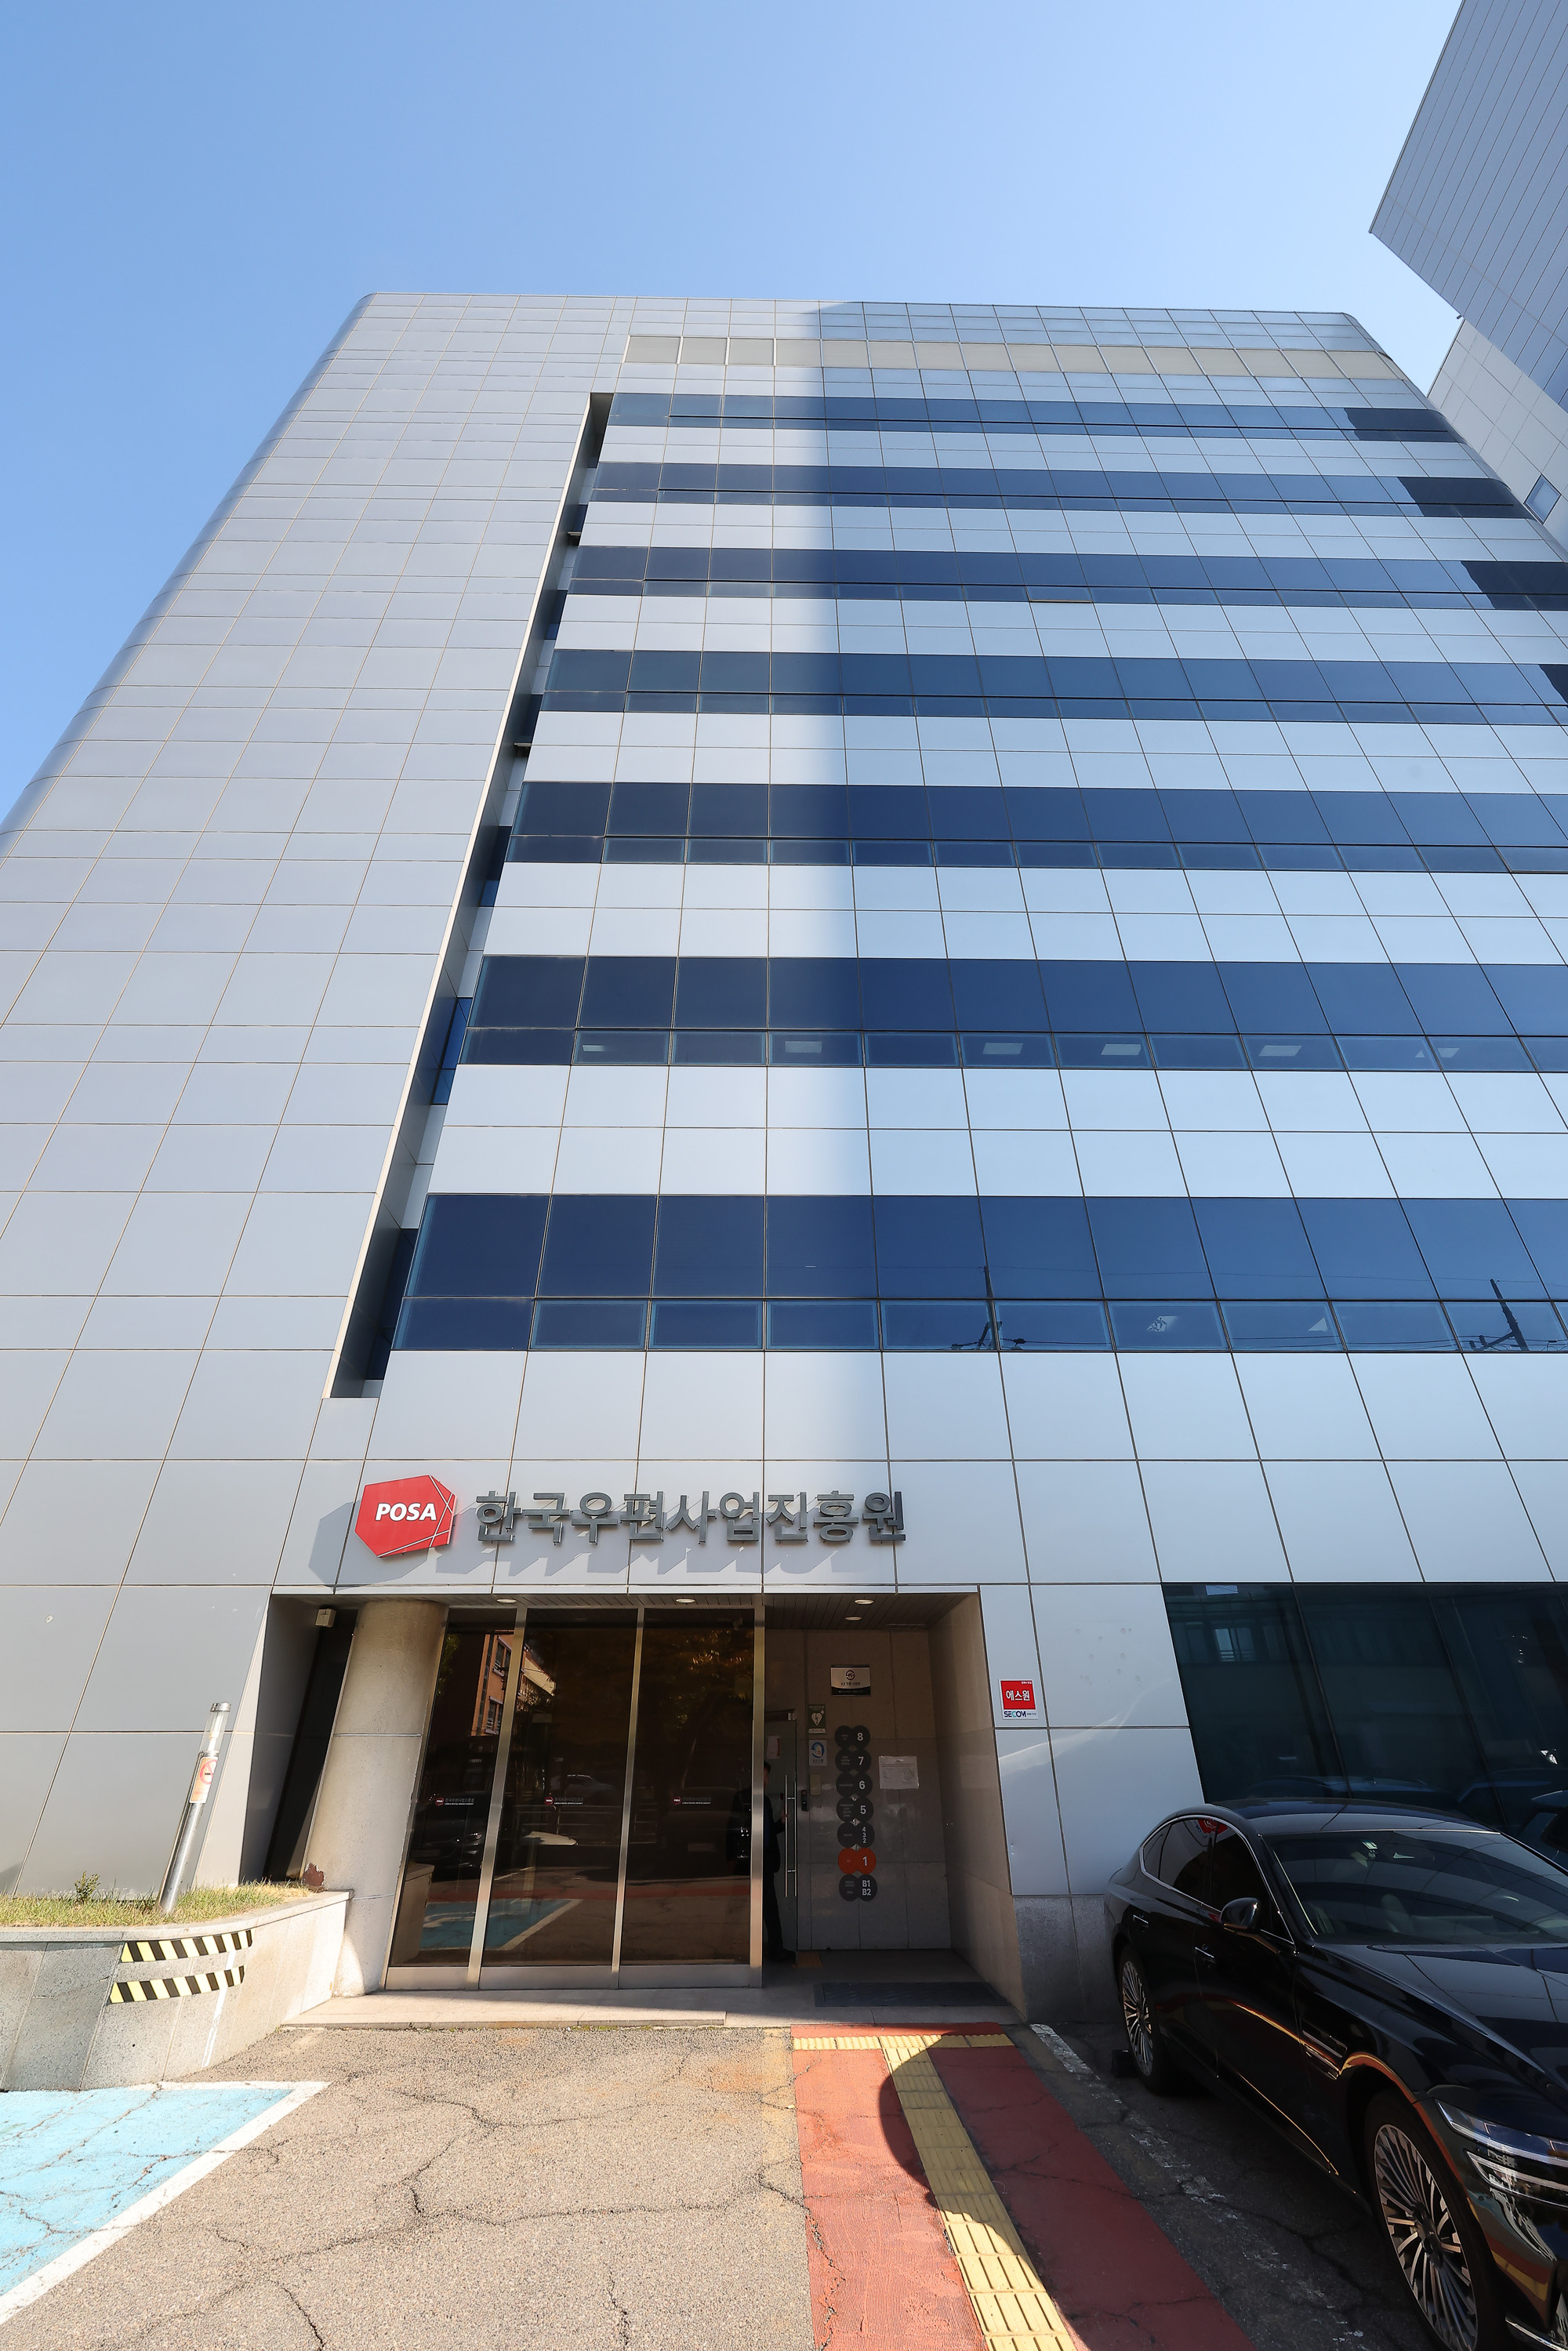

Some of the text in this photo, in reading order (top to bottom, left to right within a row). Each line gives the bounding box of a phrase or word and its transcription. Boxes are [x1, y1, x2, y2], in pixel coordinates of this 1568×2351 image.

[375, 1501, 437, 1522] POSA
[475, 1489, 906, 1546] 한국우편사업진흥원
[1005, 1689, 1031, 1701] 에스원
[857, 1732, 864, 1741] 8
[858, 1756, 865, 1765] 7
[858, 1780, 866, 1790] 6
[860, 1805, 867, 1815] 5
[862, 1856, 868, 1867] 1
